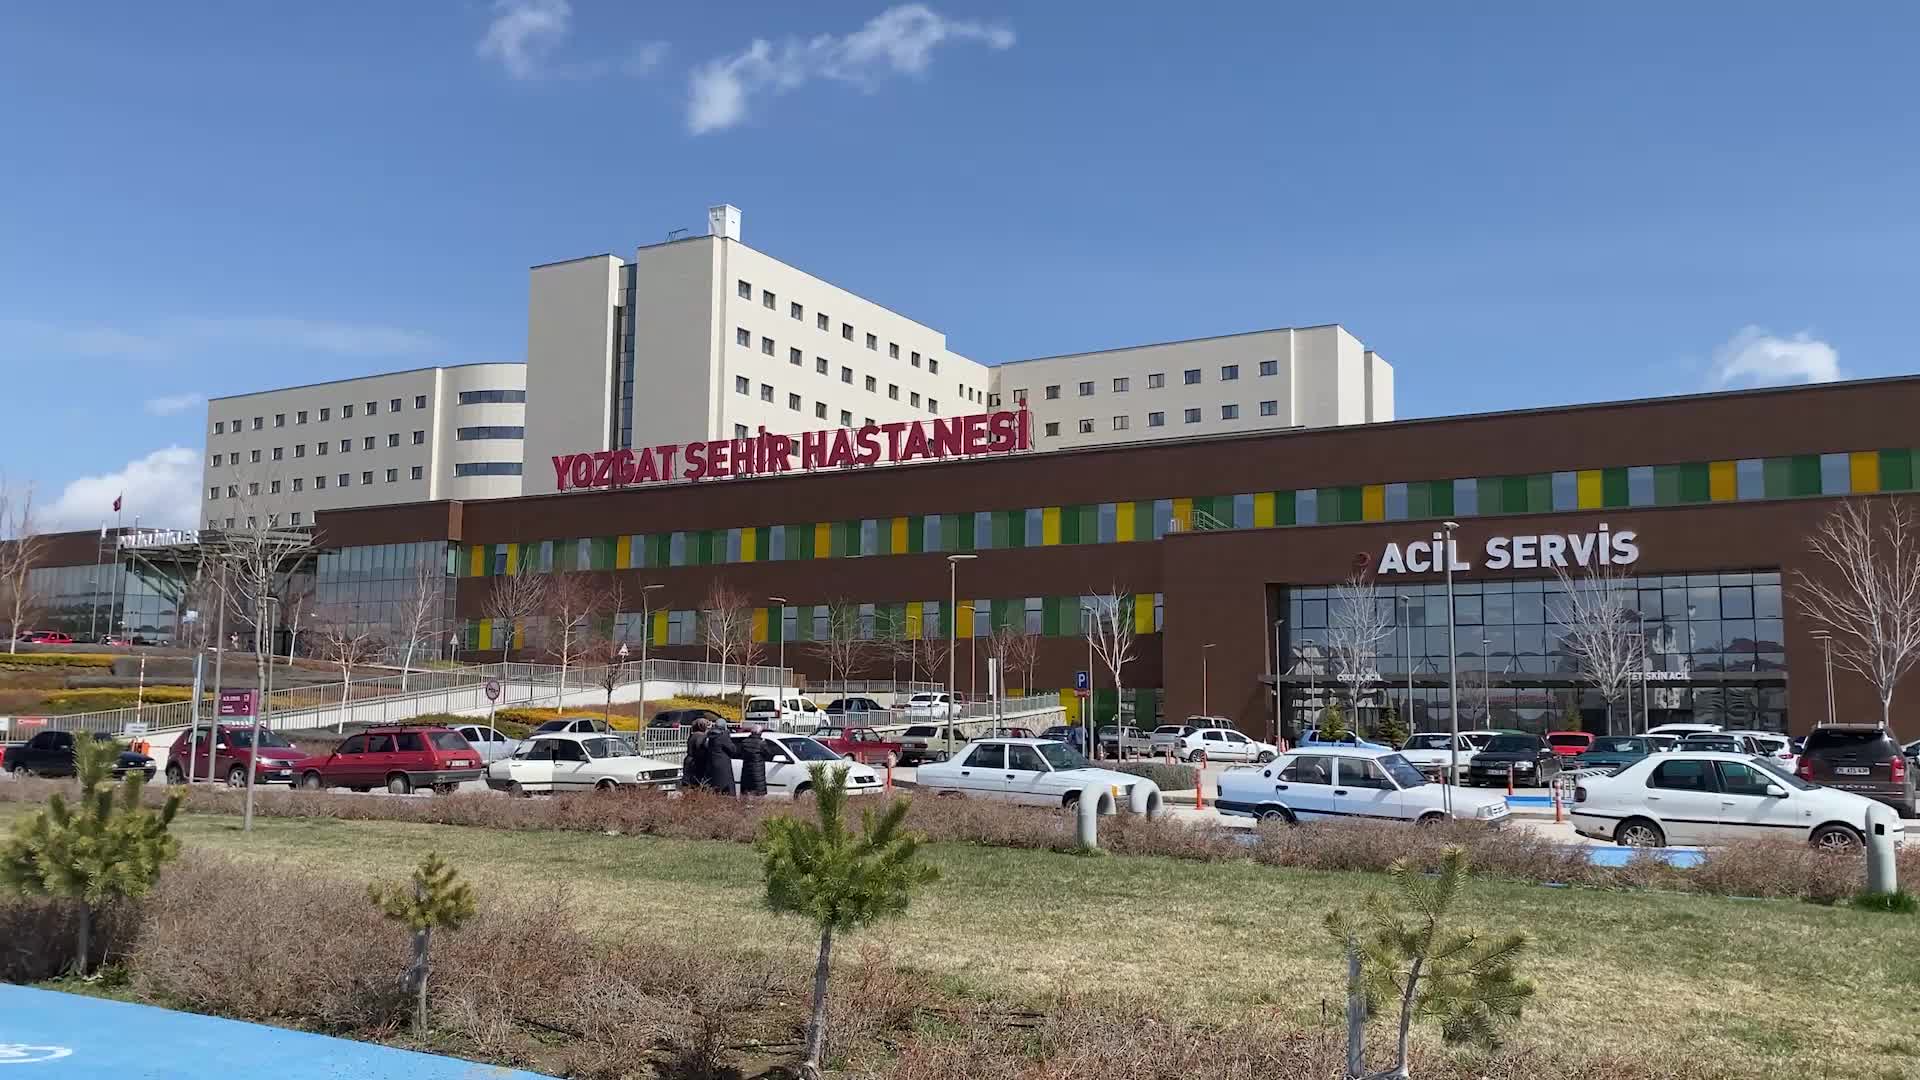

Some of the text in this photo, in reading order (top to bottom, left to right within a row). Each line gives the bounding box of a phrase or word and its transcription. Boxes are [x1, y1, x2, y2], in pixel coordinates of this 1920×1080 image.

[552, 445, 678, 490] YOZGAT
[802, 398, 1030, 467] HASTANESİ
[1378, 523, 1640, 574] ACİL SERVİS
[1078, 673, 1086, 687] P
